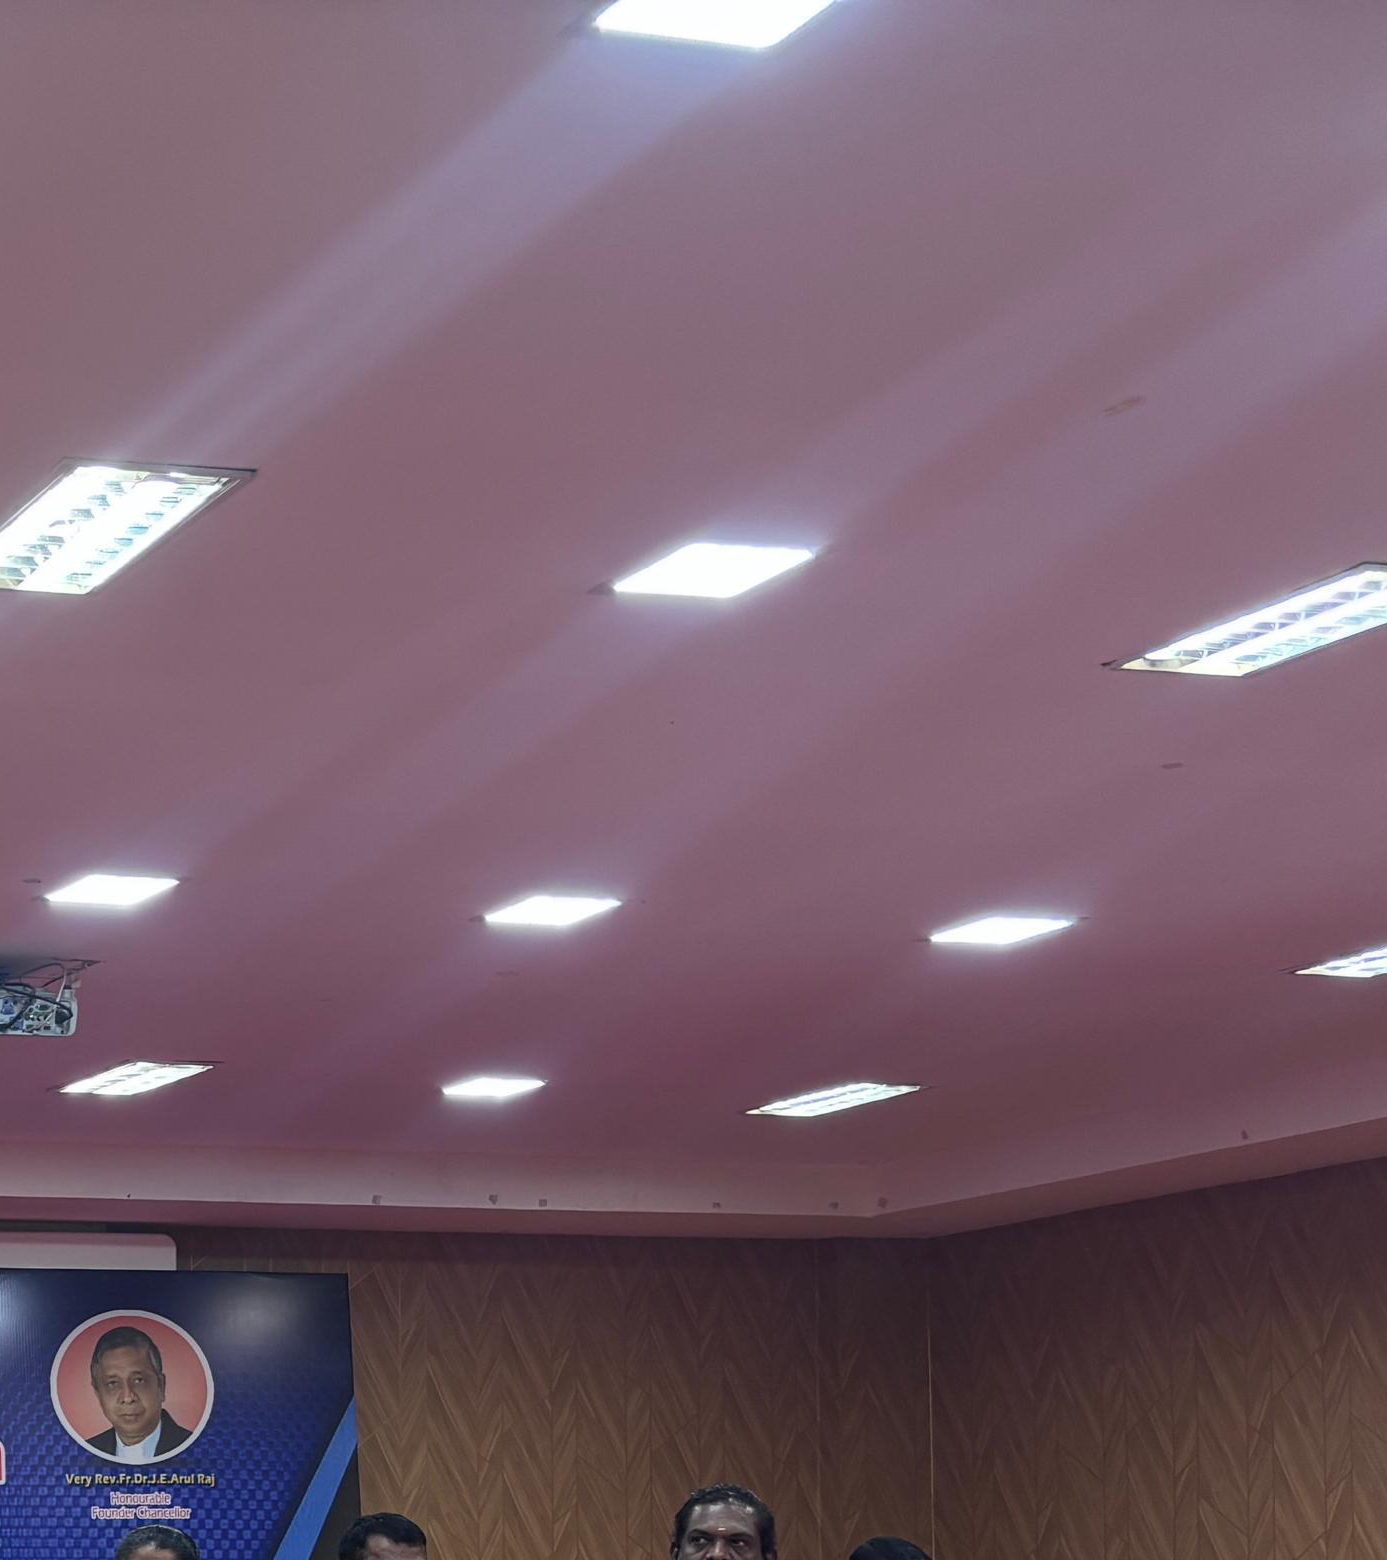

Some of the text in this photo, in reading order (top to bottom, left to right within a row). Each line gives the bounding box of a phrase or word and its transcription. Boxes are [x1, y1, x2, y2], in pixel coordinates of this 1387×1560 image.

[65, 1473, 92, 1487] Very
[197, 1473, 216, 1487] Raj
[110, 1492, 171, 1505] Honourable
[91, 1506, 192, 1519] Founder Chancellor
